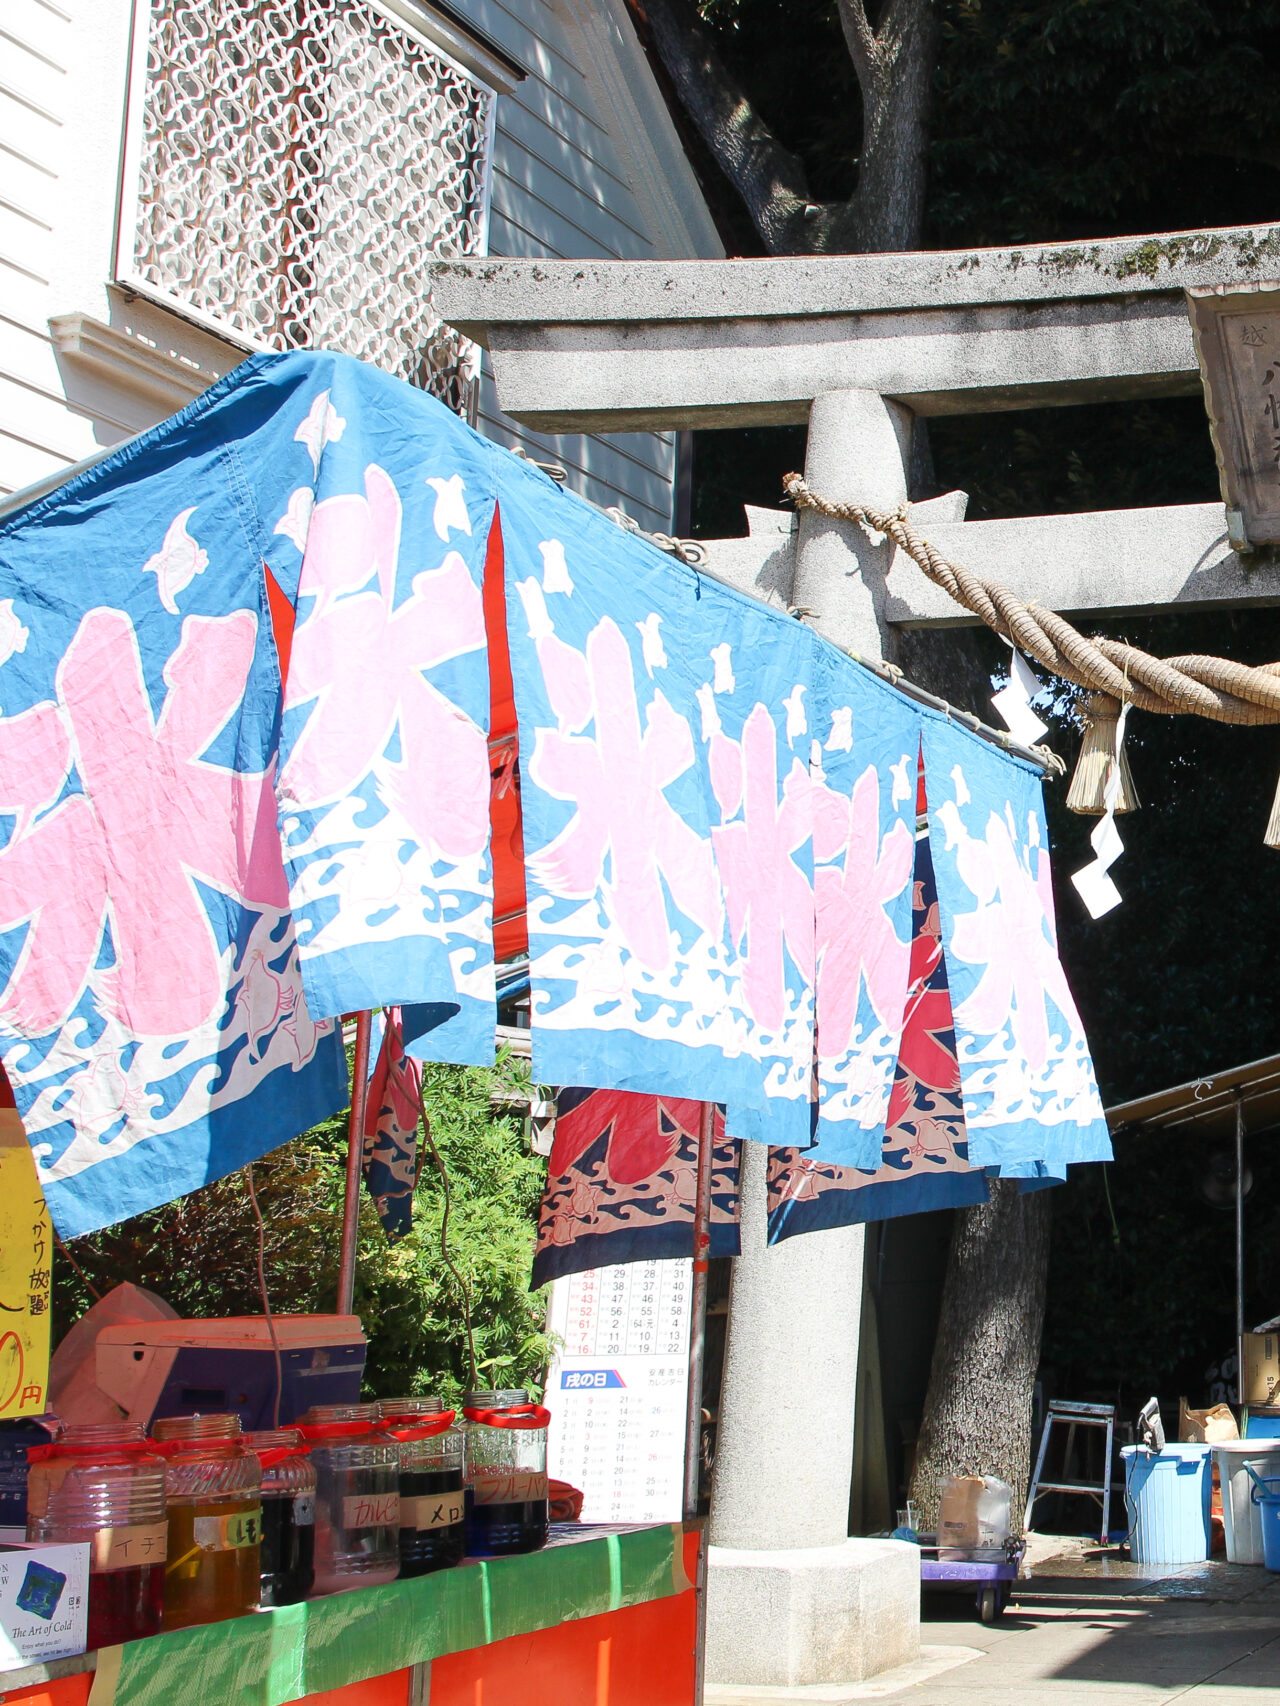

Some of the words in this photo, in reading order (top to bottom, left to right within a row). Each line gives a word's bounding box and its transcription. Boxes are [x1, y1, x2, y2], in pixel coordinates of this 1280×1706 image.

[279, 463, 492, 861] 氷
[524, 614, 726, 974] 氷
[613, 1269, 626, 1279] 29
[643, 1269, 656, 1279] 28
[673, 1269, 684, 1279] 31
[582, 1281, 594, 1291] 34
[612, 1281, 625, 1291] 38
[643, 1281, 655, 1291] 37
[672, 1281, 684, 1291] 40
[581, 1294, 593, 1303] 43
[611, 1294, 624, 1303] 47
[641, 1294, 654, 1303] 46
[671, 1294, 683, 1303] 49
[579, 1307, 592, 1316] 52
[610, 1307, 623, 1316] 56
[640, 1307, 653, 1316] 55
[670, 1306, 682, 1315] 58
[578, 1319, 590, 1329] 61
[609, 1332, 619, 1341] 11
[639, 1331, 651, 1341] 10
[669, 1331, 680, 1340] 13
[577, 1344, 589, 1354] 16
[607, 1344, 620, 1354] 20
[638, 1344, 650, 1353] 19
[667, 1343, 680, 1352] 22
[565, 1372, 606, 1388] 戌の日
[12, 1627, 27, 1639] The
[28, 1625, 43, 1637] Art
[43, 1622, 53, 1637] of
[53, 1619, 73, 1632] Cold
